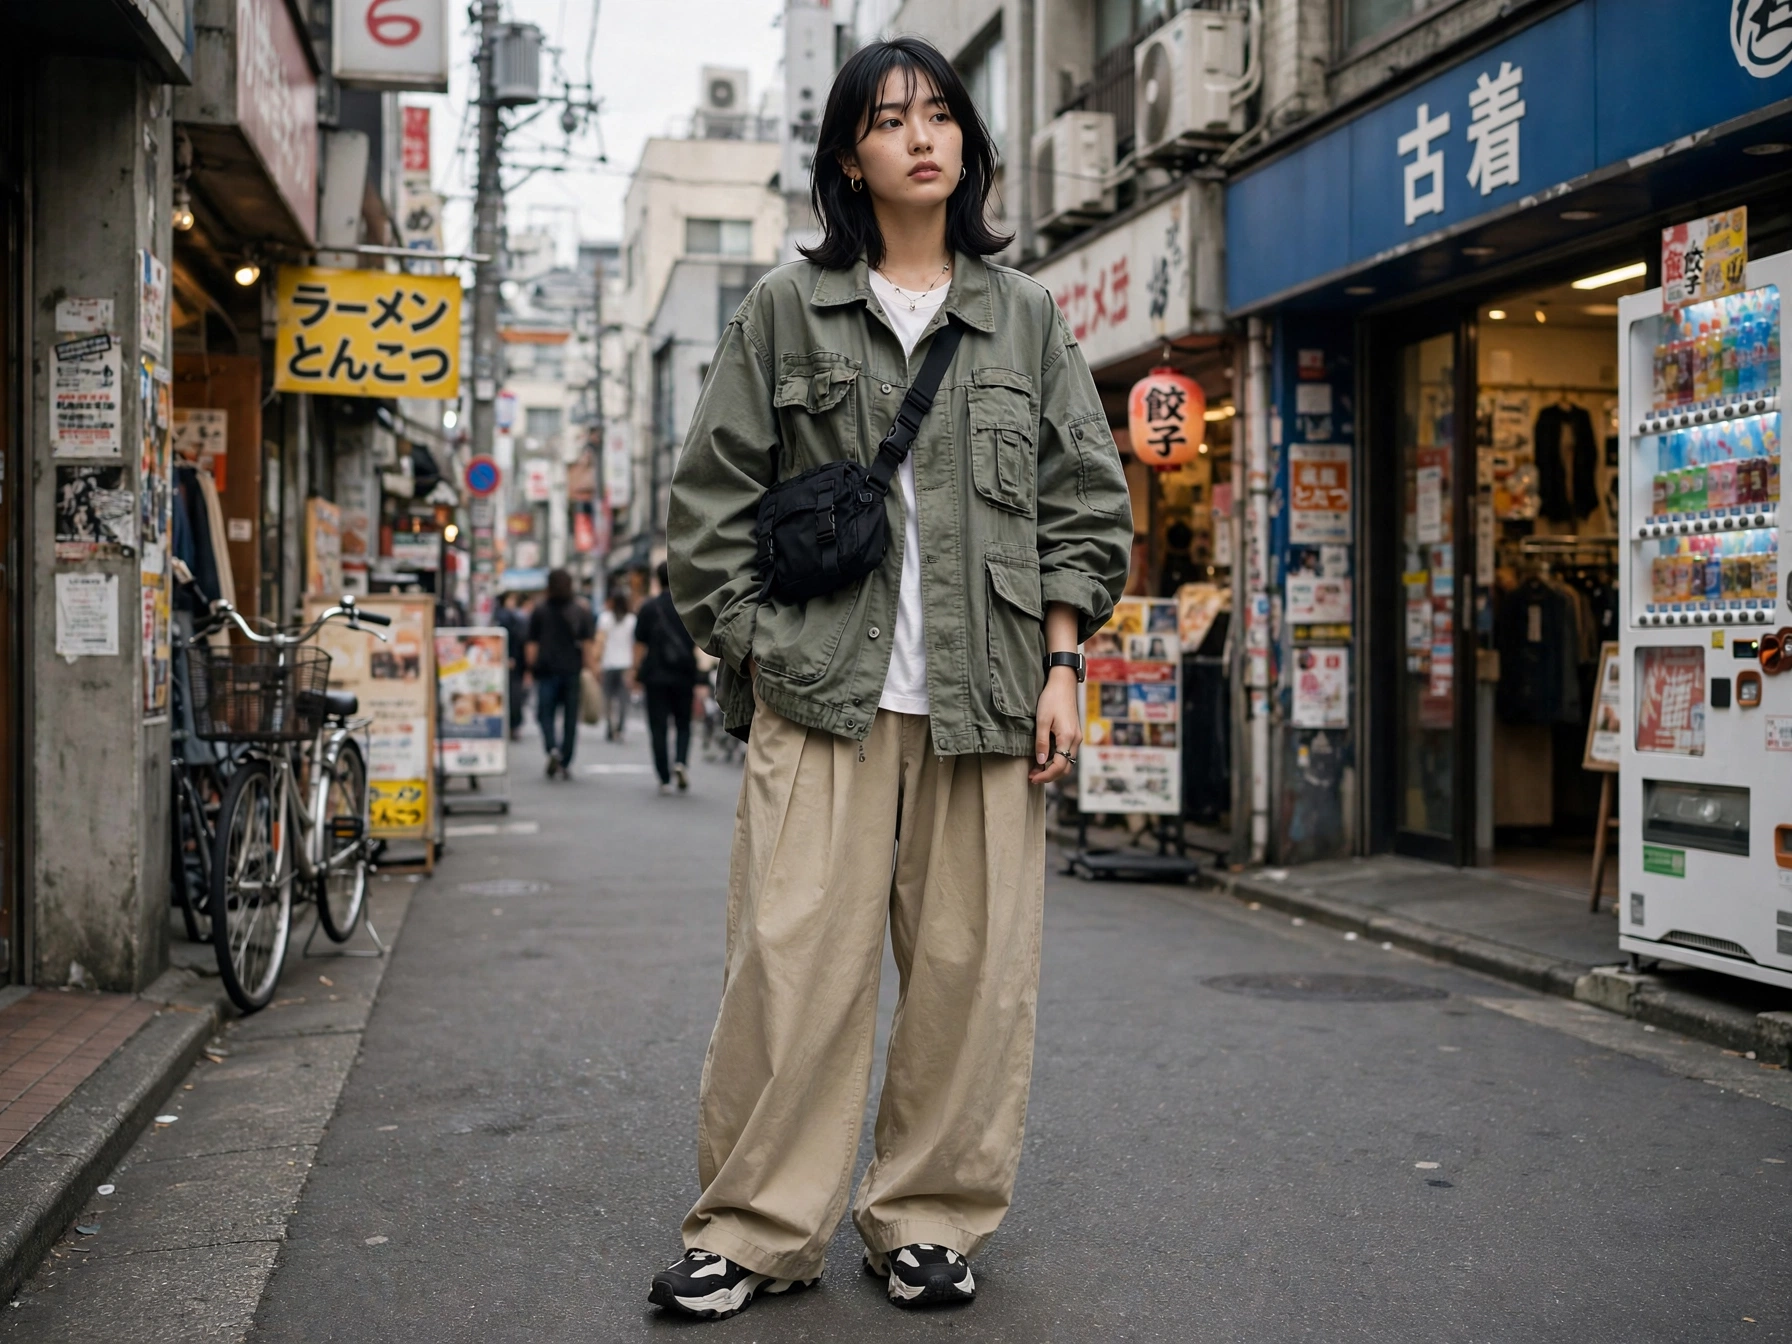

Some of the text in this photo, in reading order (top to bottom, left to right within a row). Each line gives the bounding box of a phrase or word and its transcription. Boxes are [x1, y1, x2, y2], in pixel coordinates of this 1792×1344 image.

[1397, 61, 1526, 226] 古着
[292, 285, 447, 332] ラーメン
[289, 335, 449, 382] とんこつ
[1145, 385, 1186, 457] 餃子
